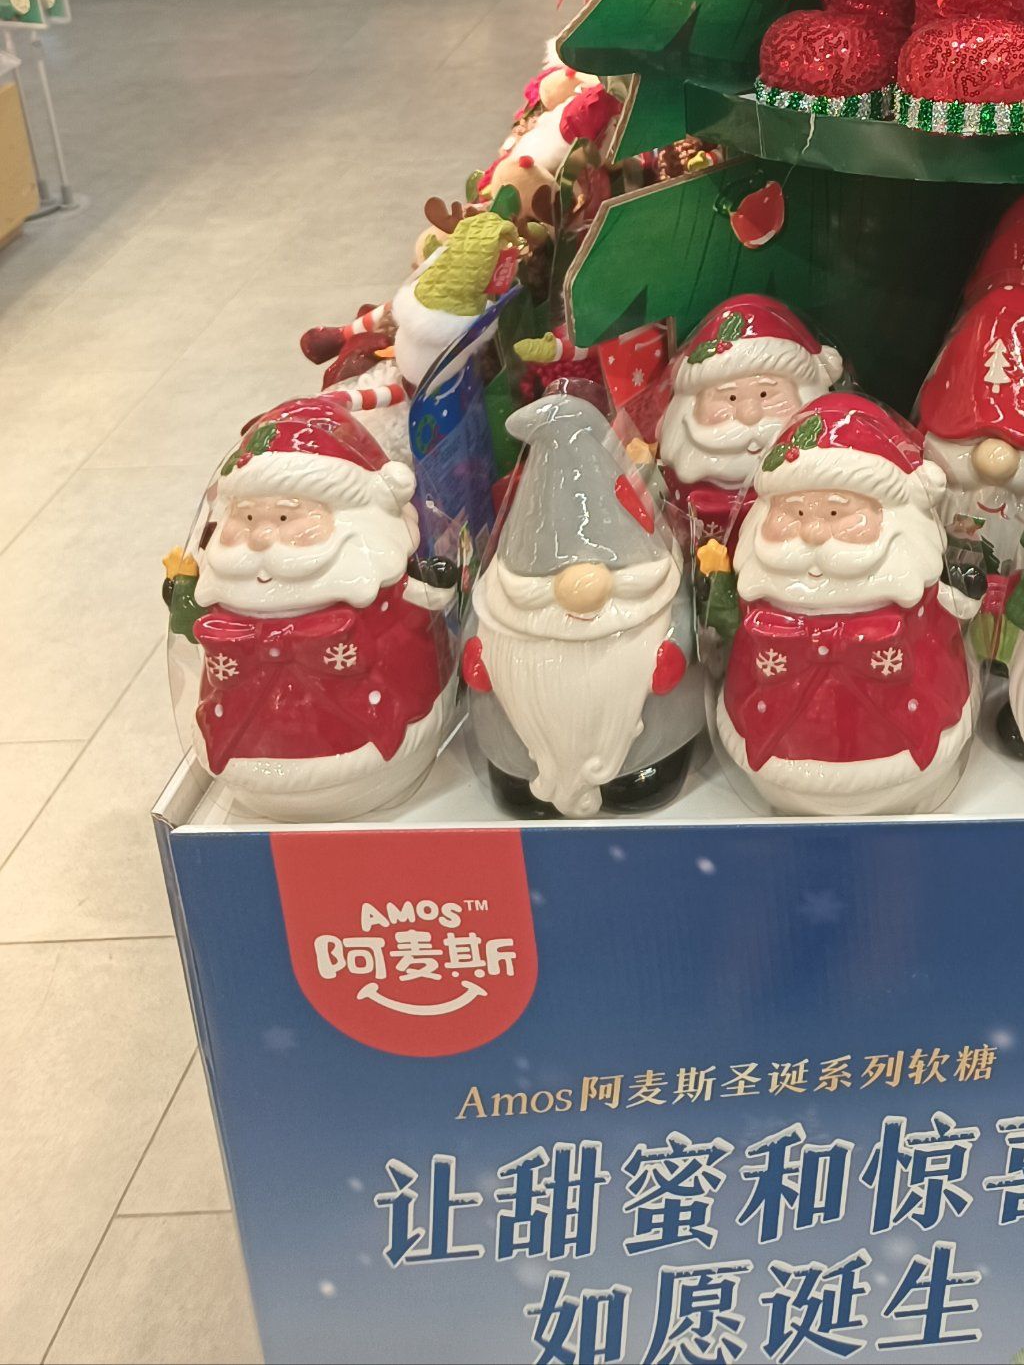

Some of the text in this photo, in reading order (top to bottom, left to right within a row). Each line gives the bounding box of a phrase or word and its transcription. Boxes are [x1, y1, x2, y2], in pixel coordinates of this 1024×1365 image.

[314, 929, 517, 982] 阿麦斯
[524, 1240, 985, 1365] 如愿诞生
